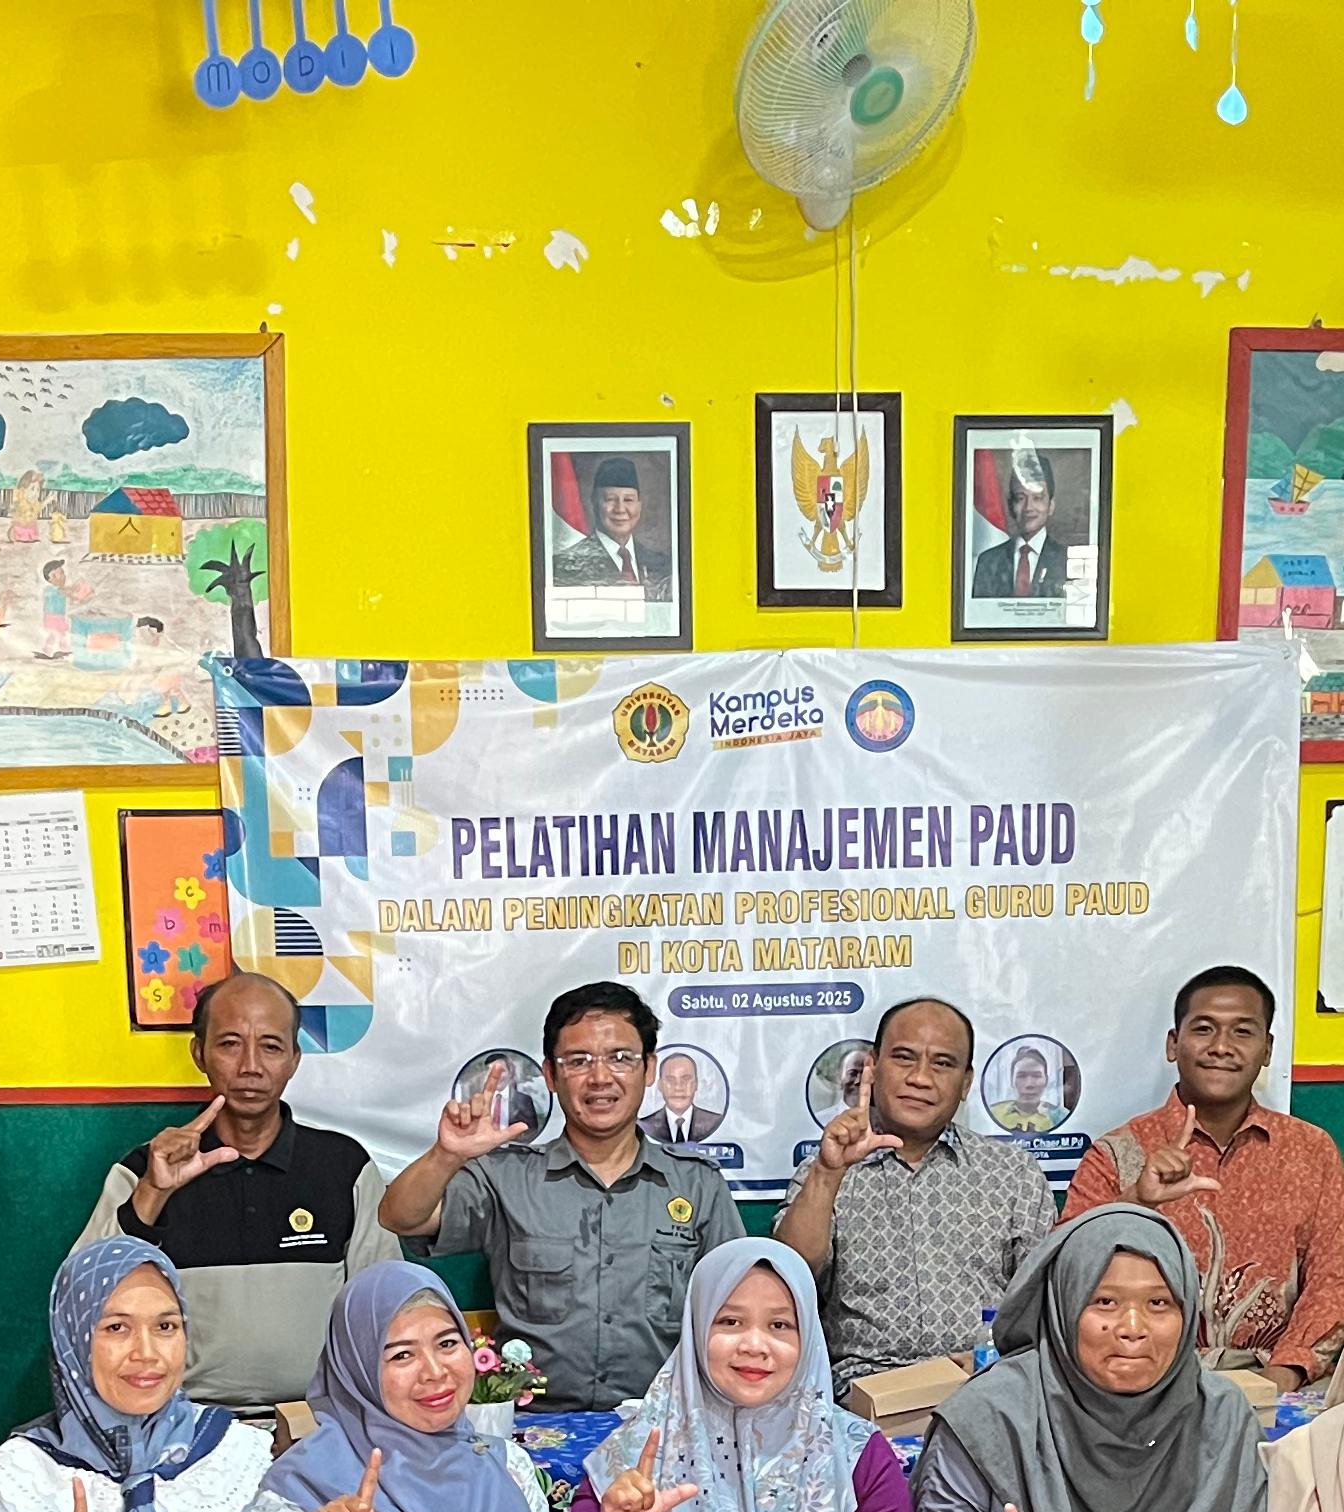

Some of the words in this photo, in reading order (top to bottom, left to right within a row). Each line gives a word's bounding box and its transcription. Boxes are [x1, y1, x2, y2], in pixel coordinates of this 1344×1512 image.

[621, 692, 681, 716] UNIVERSITAS
[709, 685, 815, 716] Kampus
[710, 705, 824, 737] Merdeka
[627, 738, 676, 756] MATARAM
[719, 733, 784, 749] INDONESIA
[788, 729, 818, 741] JAYA
[450, 812, 676, 879] PELATIHAN
[692, 805, 953, 873] MANAJEMEN
[969, 801, 1078, 866] PAUD
[378, 898, 493, 933] DALAM
[502, 891, 724, 932] PENINGKATAN
[734, 887, 955, 925] PROFESIONAL
[964, 884, 1055, 919] GURU
[1064, 881, 1150, 916] PAUD
[617, 941, 651, 975] DI
[660, 939, 743, 974] KOTA
[752, 934, 912, 970] MATARAM
[680, 995, 729, 1011] Sabtu,
[732, 993, 750, 1009] 02
[752, 992, 814, 1011] Agustus
[816, 990, 852, 1007] 2025
